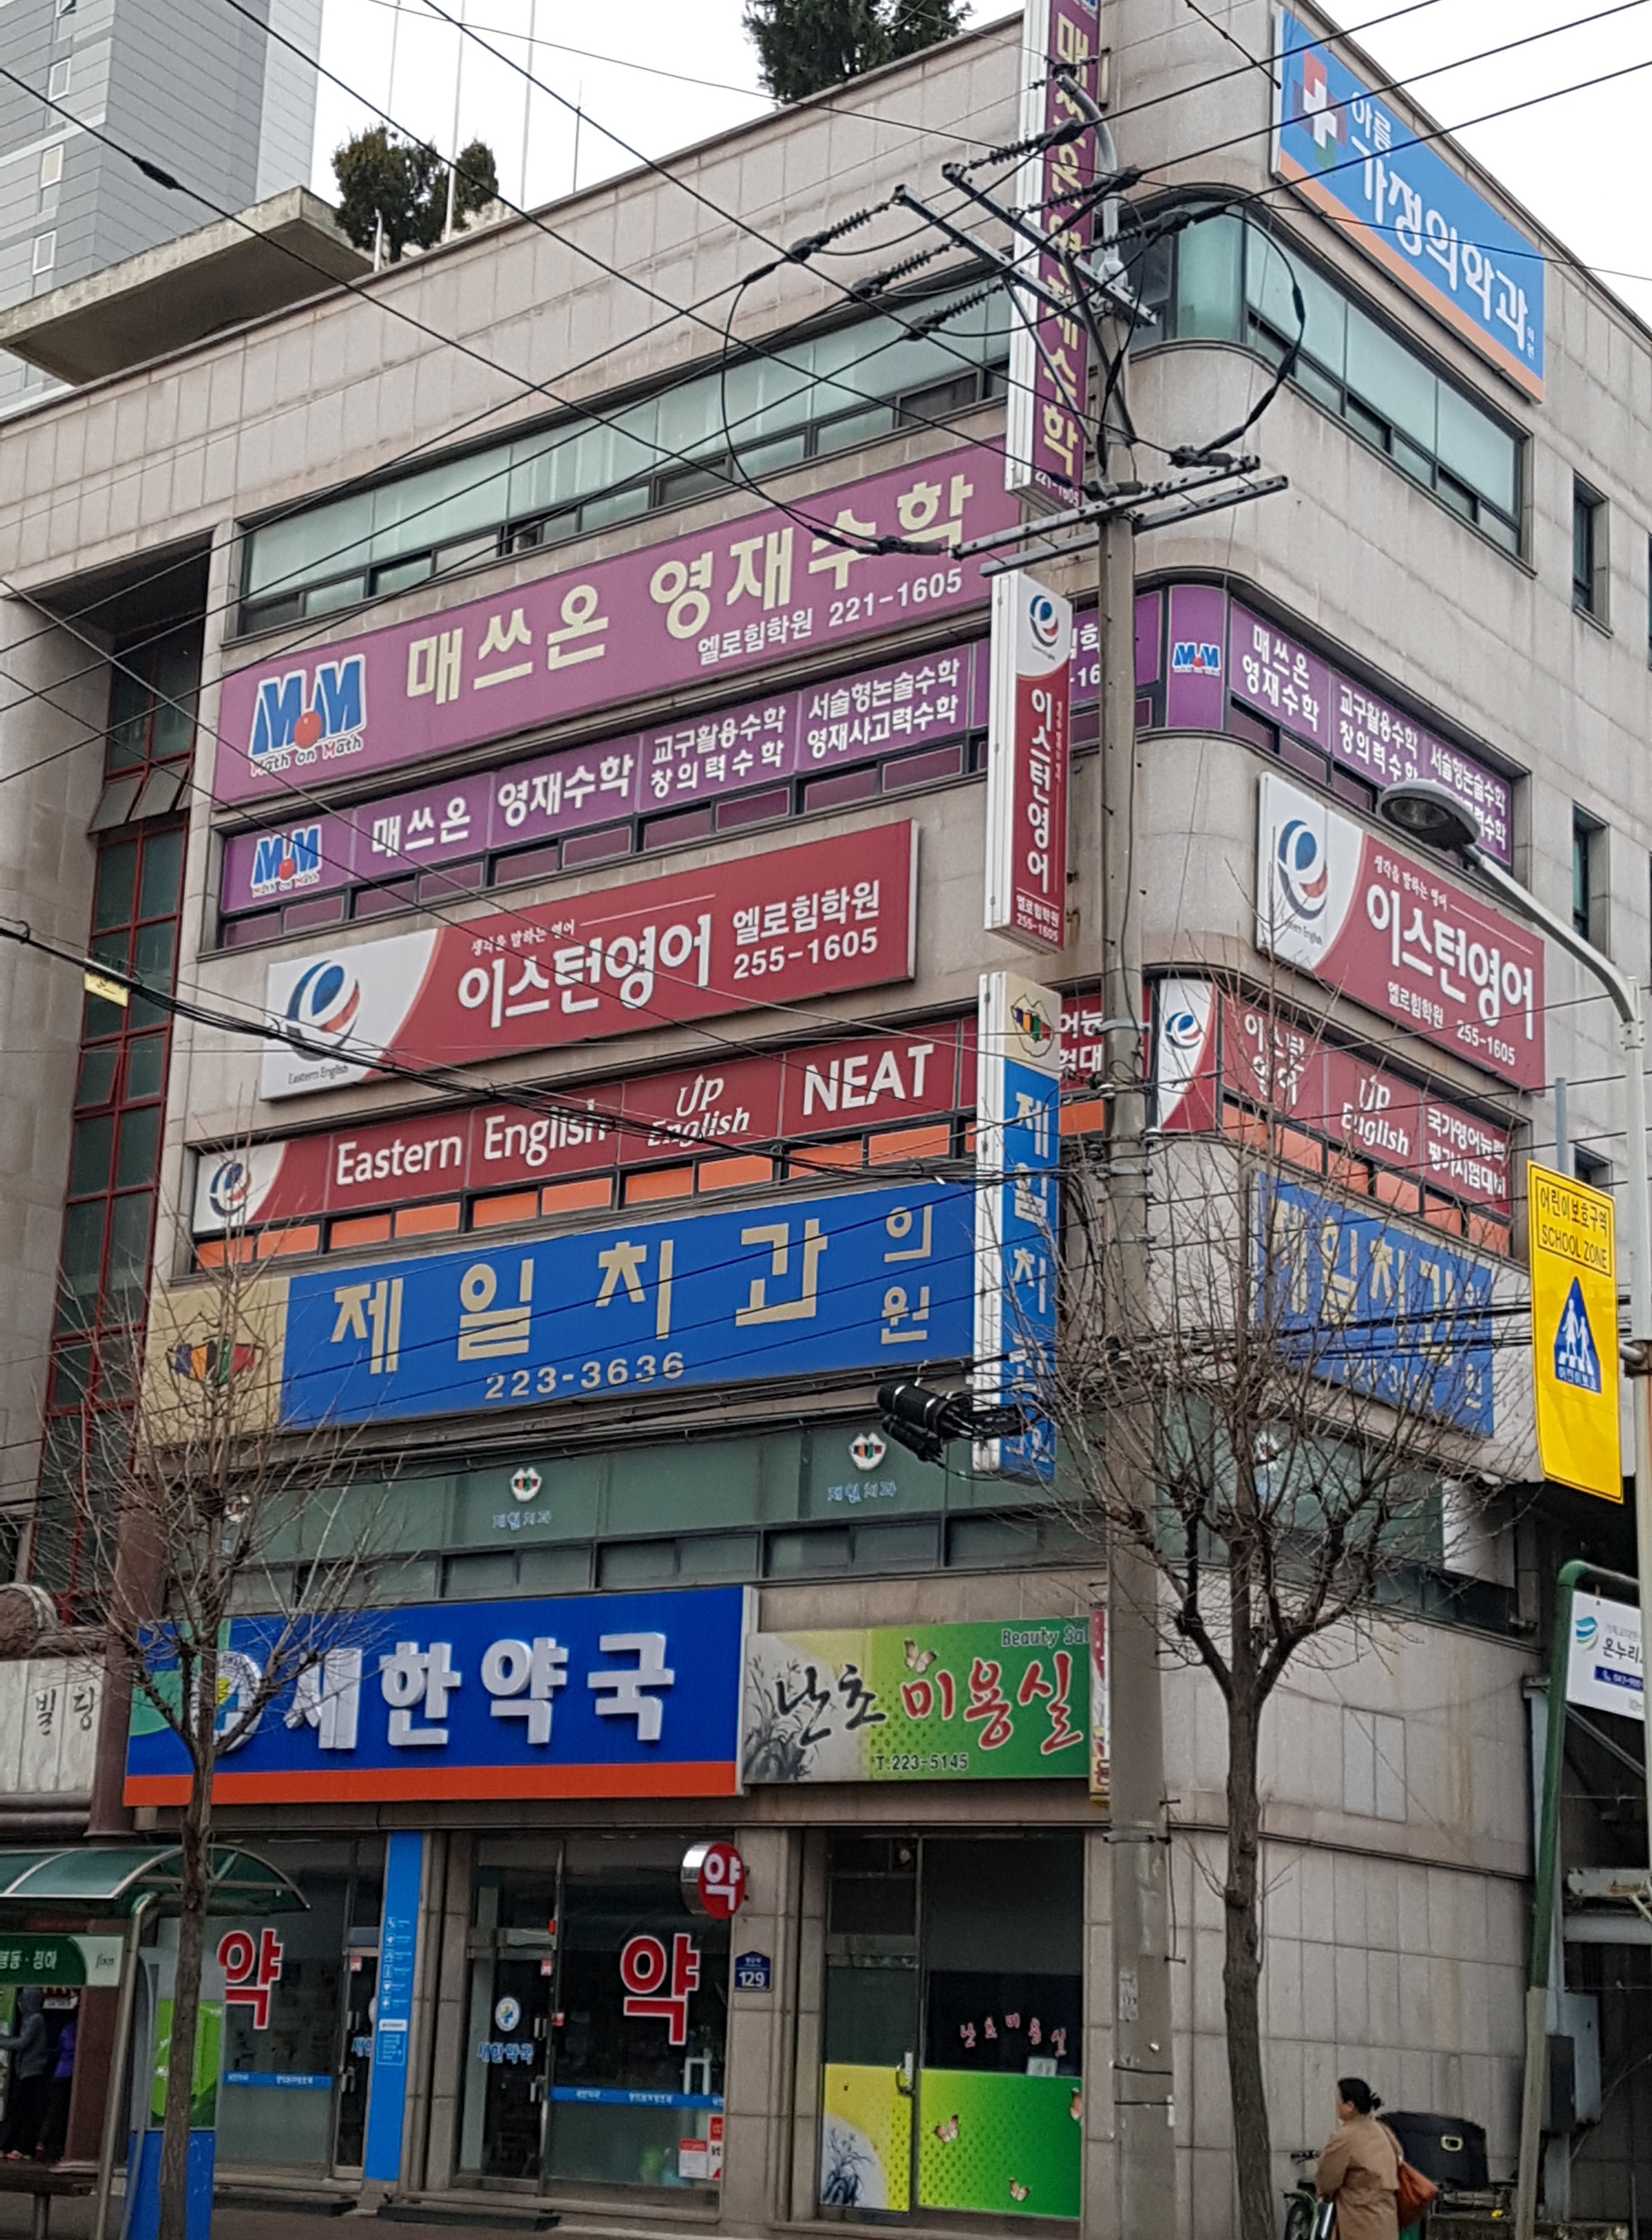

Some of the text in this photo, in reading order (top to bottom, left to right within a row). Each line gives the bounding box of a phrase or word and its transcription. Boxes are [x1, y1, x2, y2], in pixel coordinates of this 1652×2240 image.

[1350, 135, 1529, 352] 가정의학과
[406, 473, 974, 706] 매쓰온 영재수학
[697, 567, 962, 666] 엘로힘학원 221-1605
[808, 656, 960, 722] 서술형논술수학
[1253, 624, 1310, 691] 매쓰온
[806, 693, 959, 760] 영재사고력수학
[1242, 653, 1319, 733] 영재수학
[1340, 684, 1418, 760] 교구활용수학
[296, 750, 316, 766] on
[322, 733, 363, 760] Math
[650, 739, 784, 799] 창의력수학
[651, 705, 786, 766] 교구활용수학
[371, 752, 635, 858] 매쓰온 영재수학
[1027, 688, 1053, 894] 이스턴영어
[1429, 742, 1506, 817] 서술형논술수학
[510, 927, 546, 947] 말하는
[732, 879, 881, 946] 엘로힘학원
[457, 913, 712, 1029] 이스턴영어
[733, 927, 878, 980] 255-1605
[1366, 884, 1534, 1041] 이스턴영어
[1388, 981, 1516, 1066] 엘로힘학원 255-1605
[675, 1074, 725, 1117] Up
[802, 1044, 935, 1117] NEAT
[336, 1099, 606, 1186] Eastern English
[647, 1107, 750, 1148] English
[1341, 1102, 1410, 1158] English
[1539, 1185, 1609, 1238] 어린이보호구역
[1541, 1223, 1608, 1271] SCHOOL ZONE
[330, 1204, 933, 1375] 제일치과 의원
[484, 1351, 685, 1401] 223-3636
[1002, 1627, 1090, 1648] Beauty Sal
[1602, 1638, 1643, 1665] 온누리
[774, 1651, 1084, 1756] 난초 미용실
[875, 1753, 969, 1772] T.223-5145
[703, 1852, 742, 1911] 약
[216, 1927, 284, 2030] 약
[620, 1932, 701, 2046] 약
[738, 1970, 766, 1988] 129
